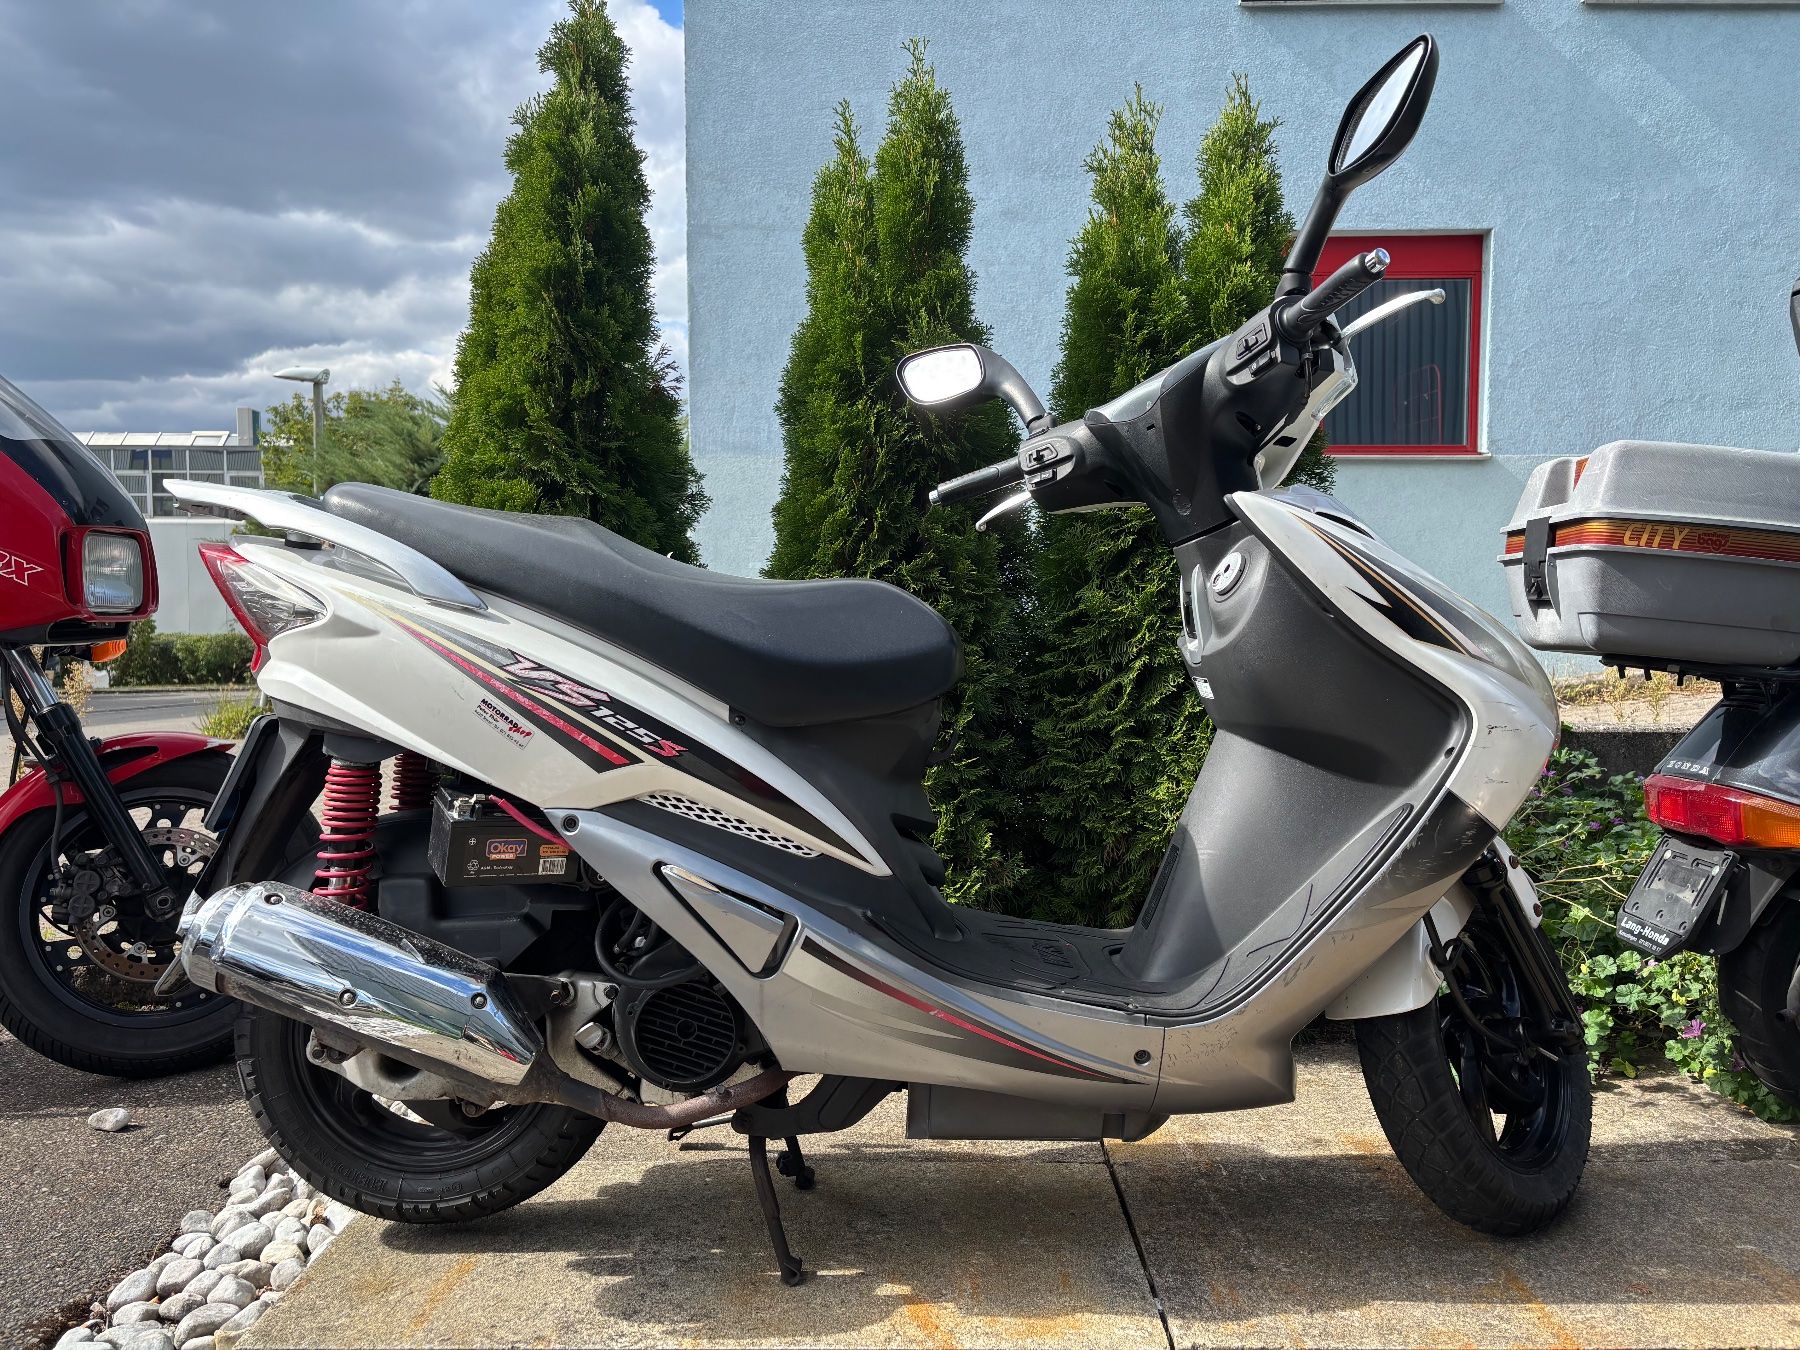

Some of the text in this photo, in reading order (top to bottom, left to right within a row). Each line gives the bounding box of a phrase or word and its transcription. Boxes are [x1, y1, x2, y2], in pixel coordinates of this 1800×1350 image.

[1623, 523, 1689, 549] CITY
[481, 699, 518, 728] MOTORRAD
[490, 842, 524, 854] Okay
[1620, 916, 1670, 946] Lang-Honda
